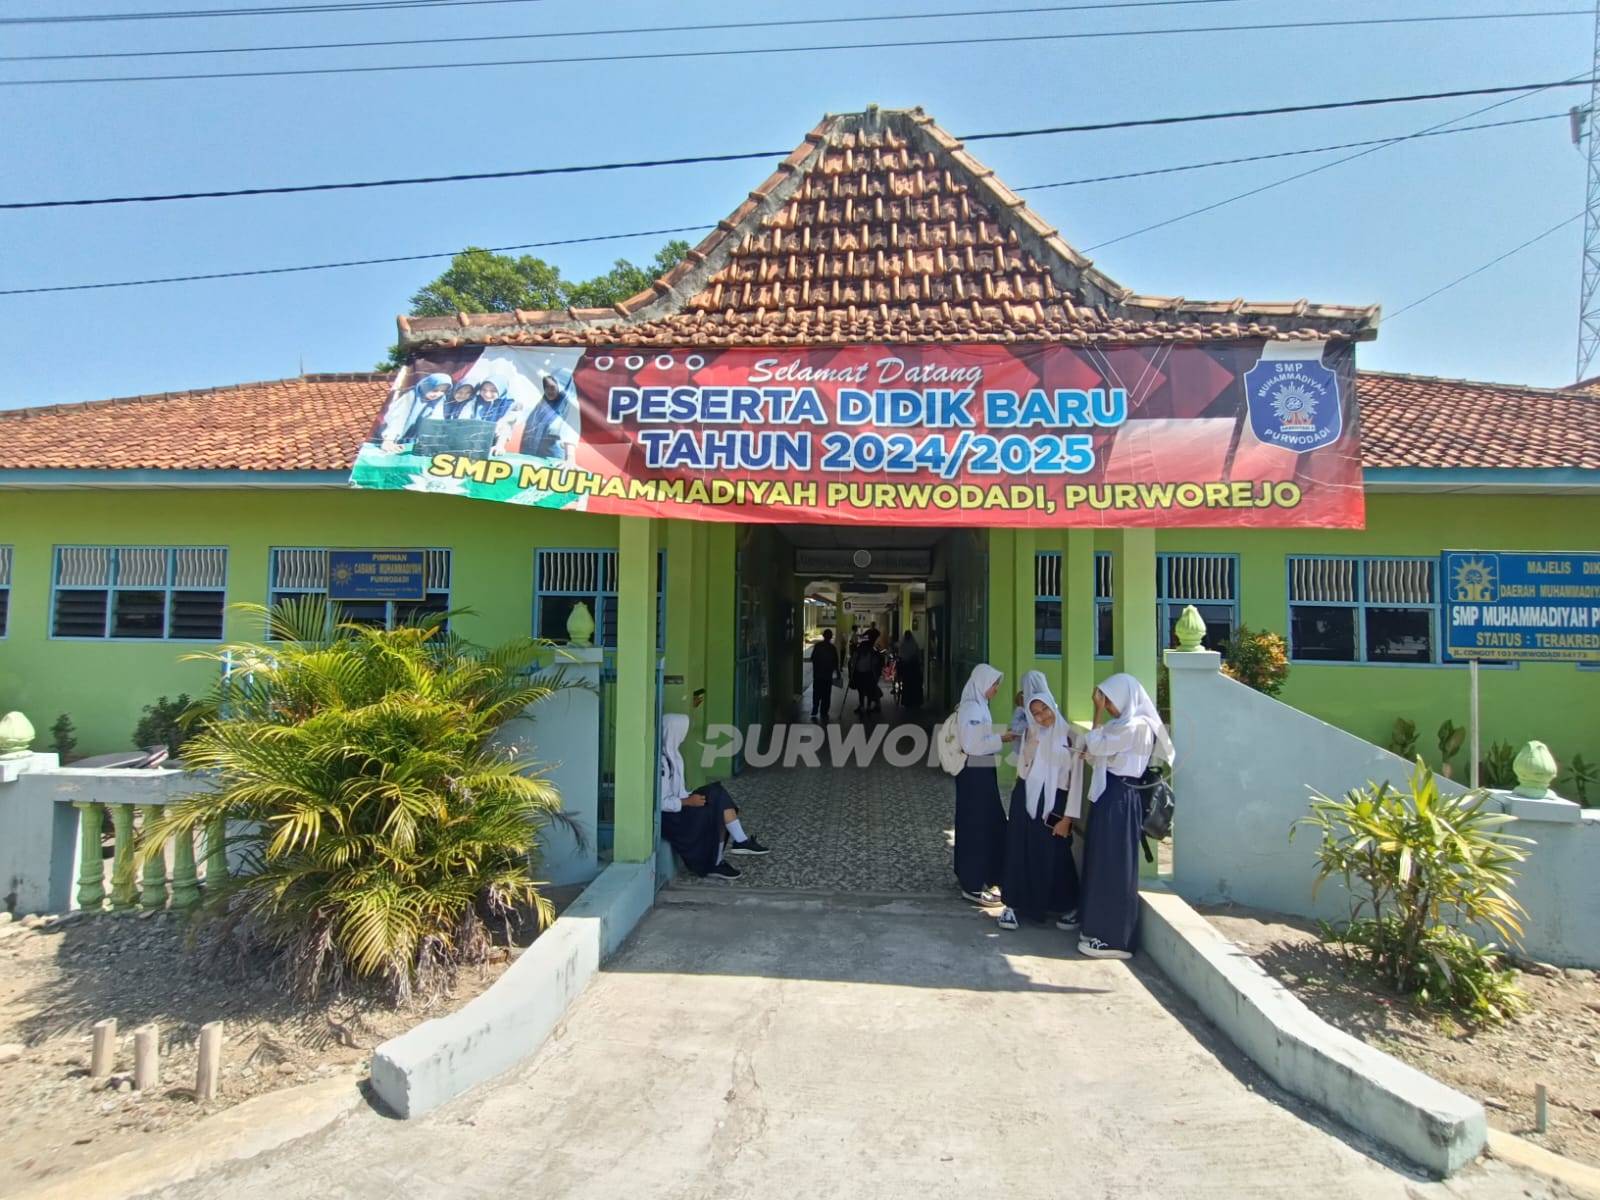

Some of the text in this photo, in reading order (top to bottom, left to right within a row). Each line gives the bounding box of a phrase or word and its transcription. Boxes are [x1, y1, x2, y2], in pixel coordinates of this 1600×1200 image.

[748, 357, 984, 391] Selamat Datang
[1275, 363, 1303, 373] SMP
[1258, 372, 1327, 397] MUHAMMADIYAH
[606, 386, 1128, 428] PESERTA DIDIK BARU
[1264, 426, 1332, 445] PURWODADI
[637, 428, 1094, 479] TAHUN 2024/2025
[429, 453, 1302, 514] SMP MUHAMMADIYAH PURWODADI, PURWOREJO
[1527, 561, 1572, 574] MAJELIS
[1501, 584, 1536, 597] DAERAH
[1452, 606, 1479, 626] SMP
[1483, 606, 1588, 627] MUHAMMADIYAH
[1476, 632, 1522, 647] STATUS
